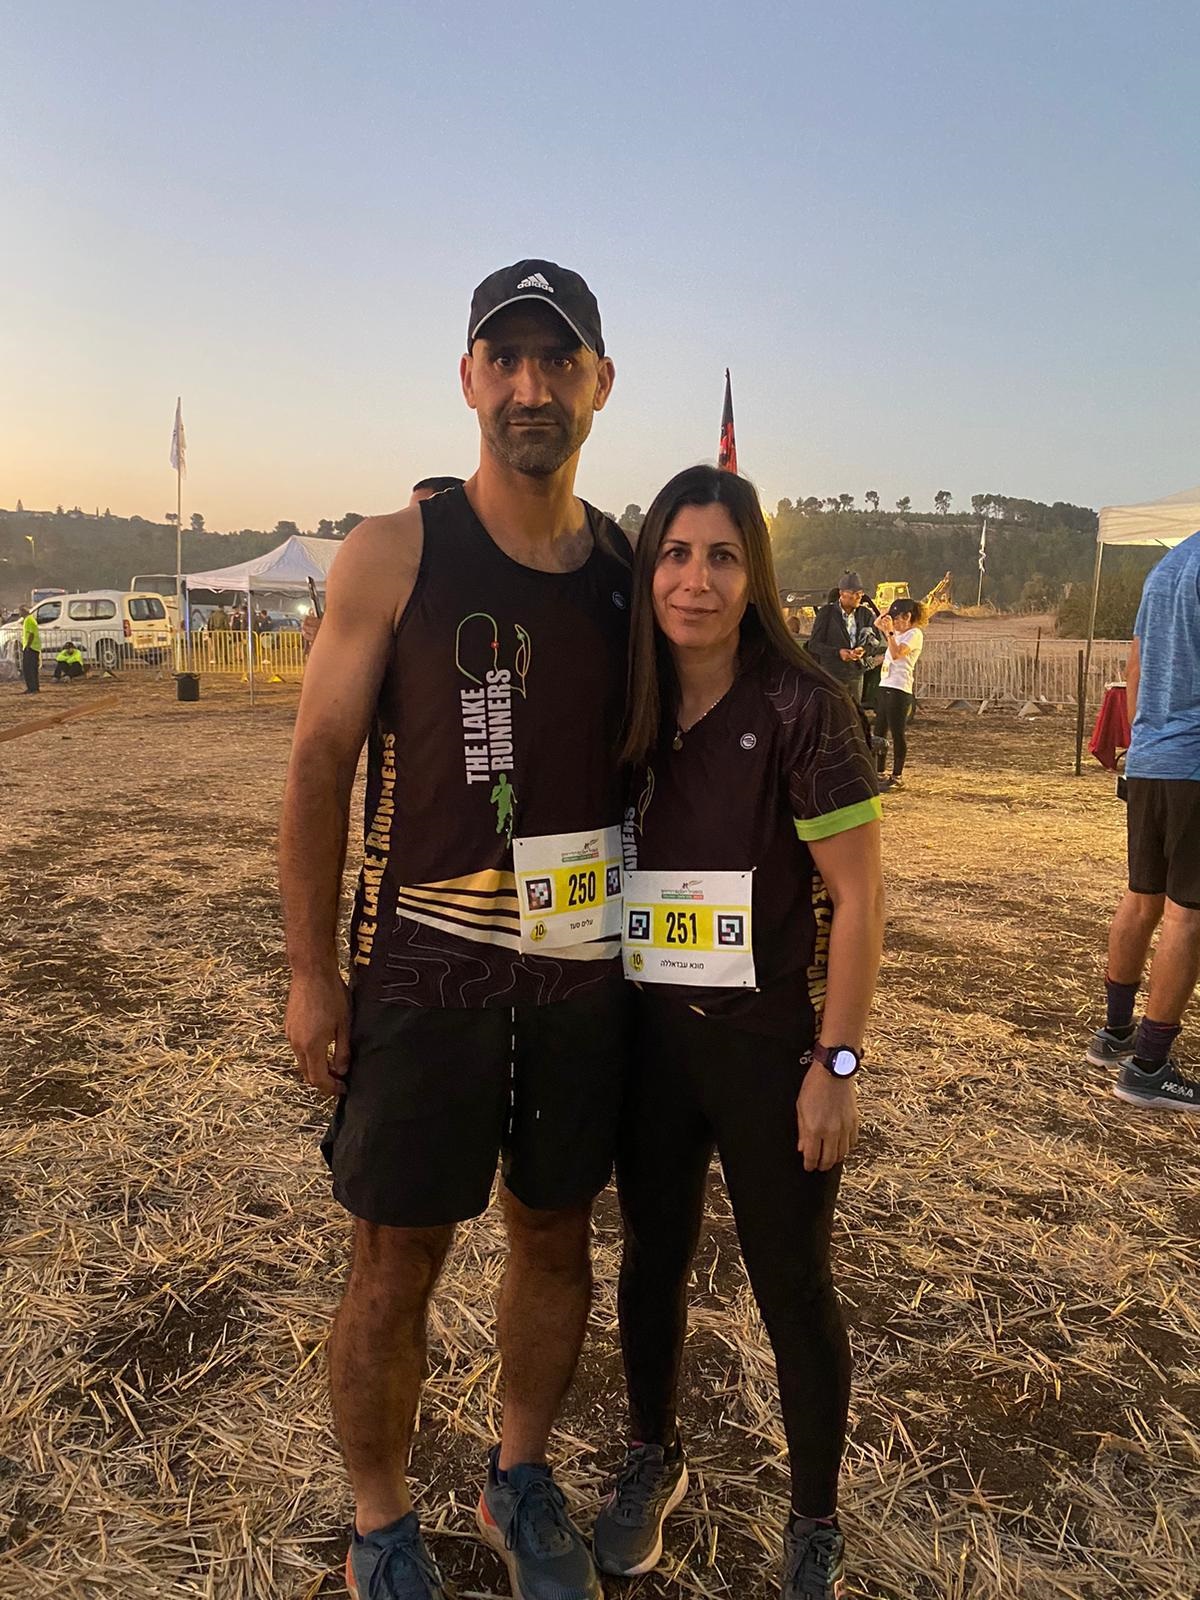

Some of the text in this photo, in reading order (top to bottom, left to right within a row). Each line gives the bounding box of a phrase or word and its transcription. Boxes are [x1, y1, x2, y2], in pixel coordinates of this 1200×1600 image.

[516, 280, 554, 293] adidas
[461, 688, 490, 784] THE LAKE
[486, 669, 514, 770] RUNNERS
[354, 733, 397, 966] THE LAKE RUNNERS
[622, 807, 638, 870] NNERS
[568, 871, 596, 906] 250
[535, 924, 545, 936] 10
[666, 911, 697, 944] 251
[632, 953, 641, 966] 10
[1161, 1081, 1194, 1098] HOKA
